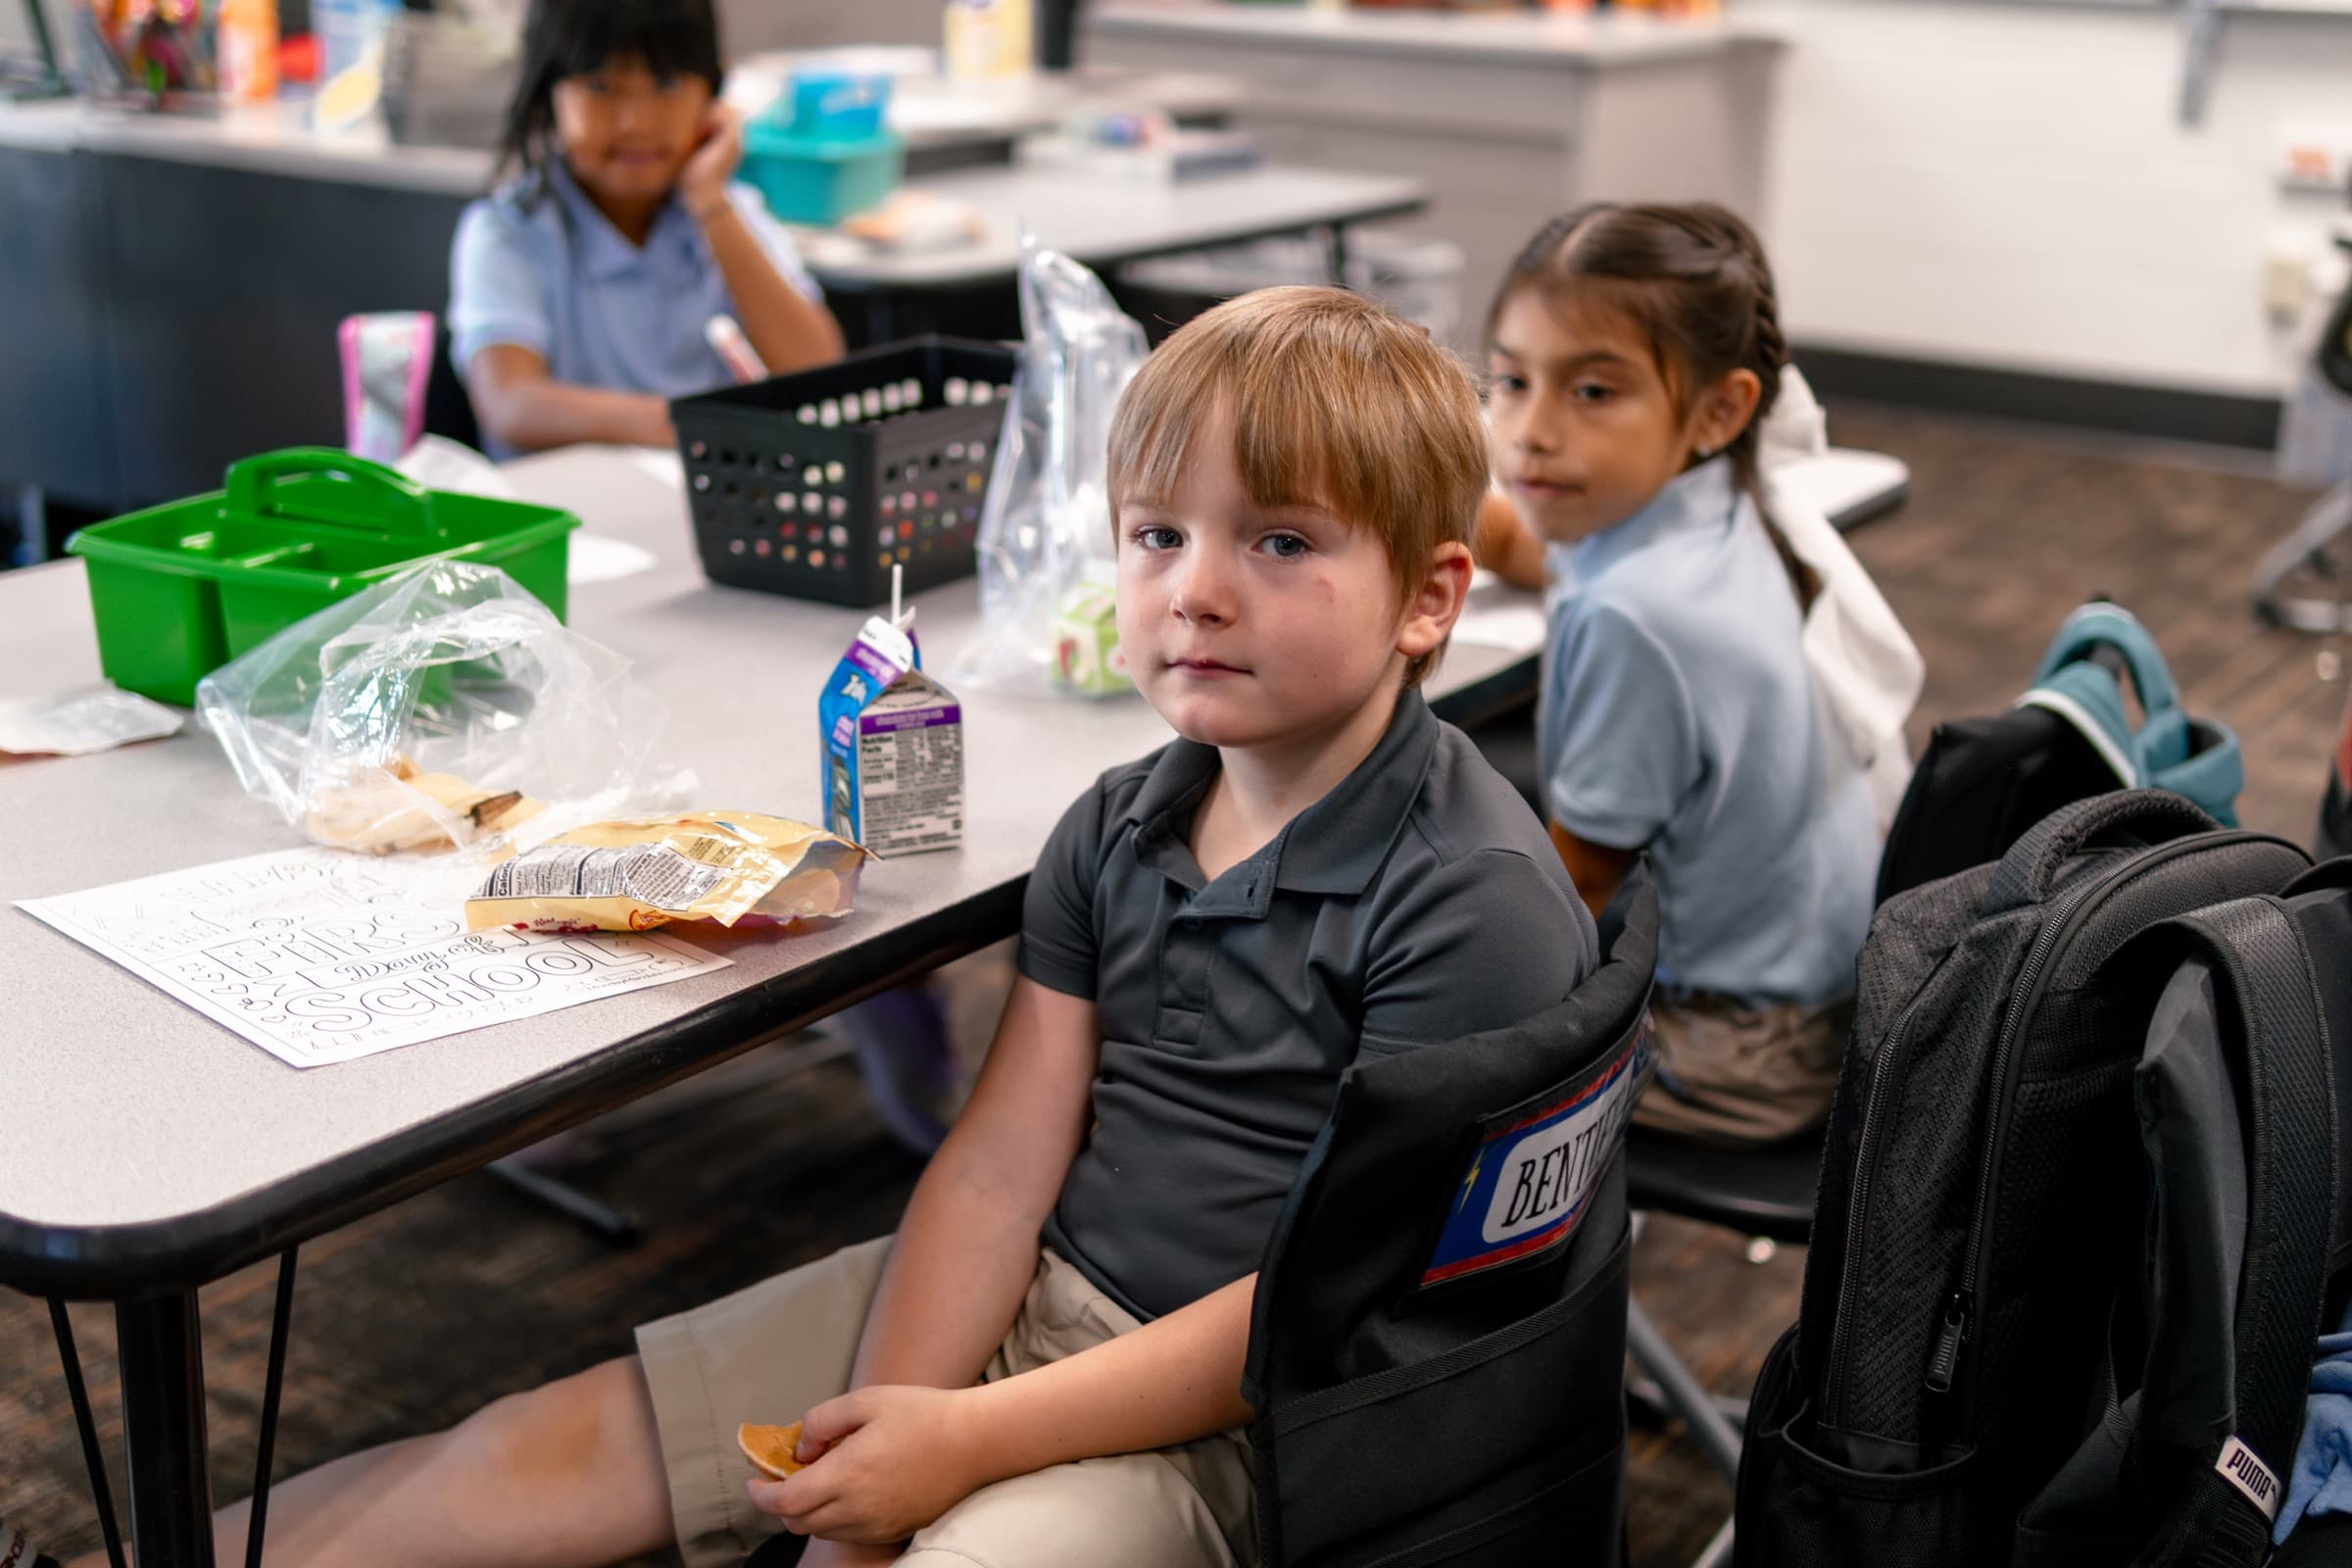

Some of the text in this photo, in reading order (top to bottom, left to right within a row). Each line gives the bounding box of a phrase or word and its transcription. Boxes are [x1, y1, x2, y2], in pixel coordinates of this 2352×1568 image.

[285, 938, 655, 1032] SCHOOL
[334, 935, 506, 982] Day of
[2227, 1447, 2272, 1500] PUMA
